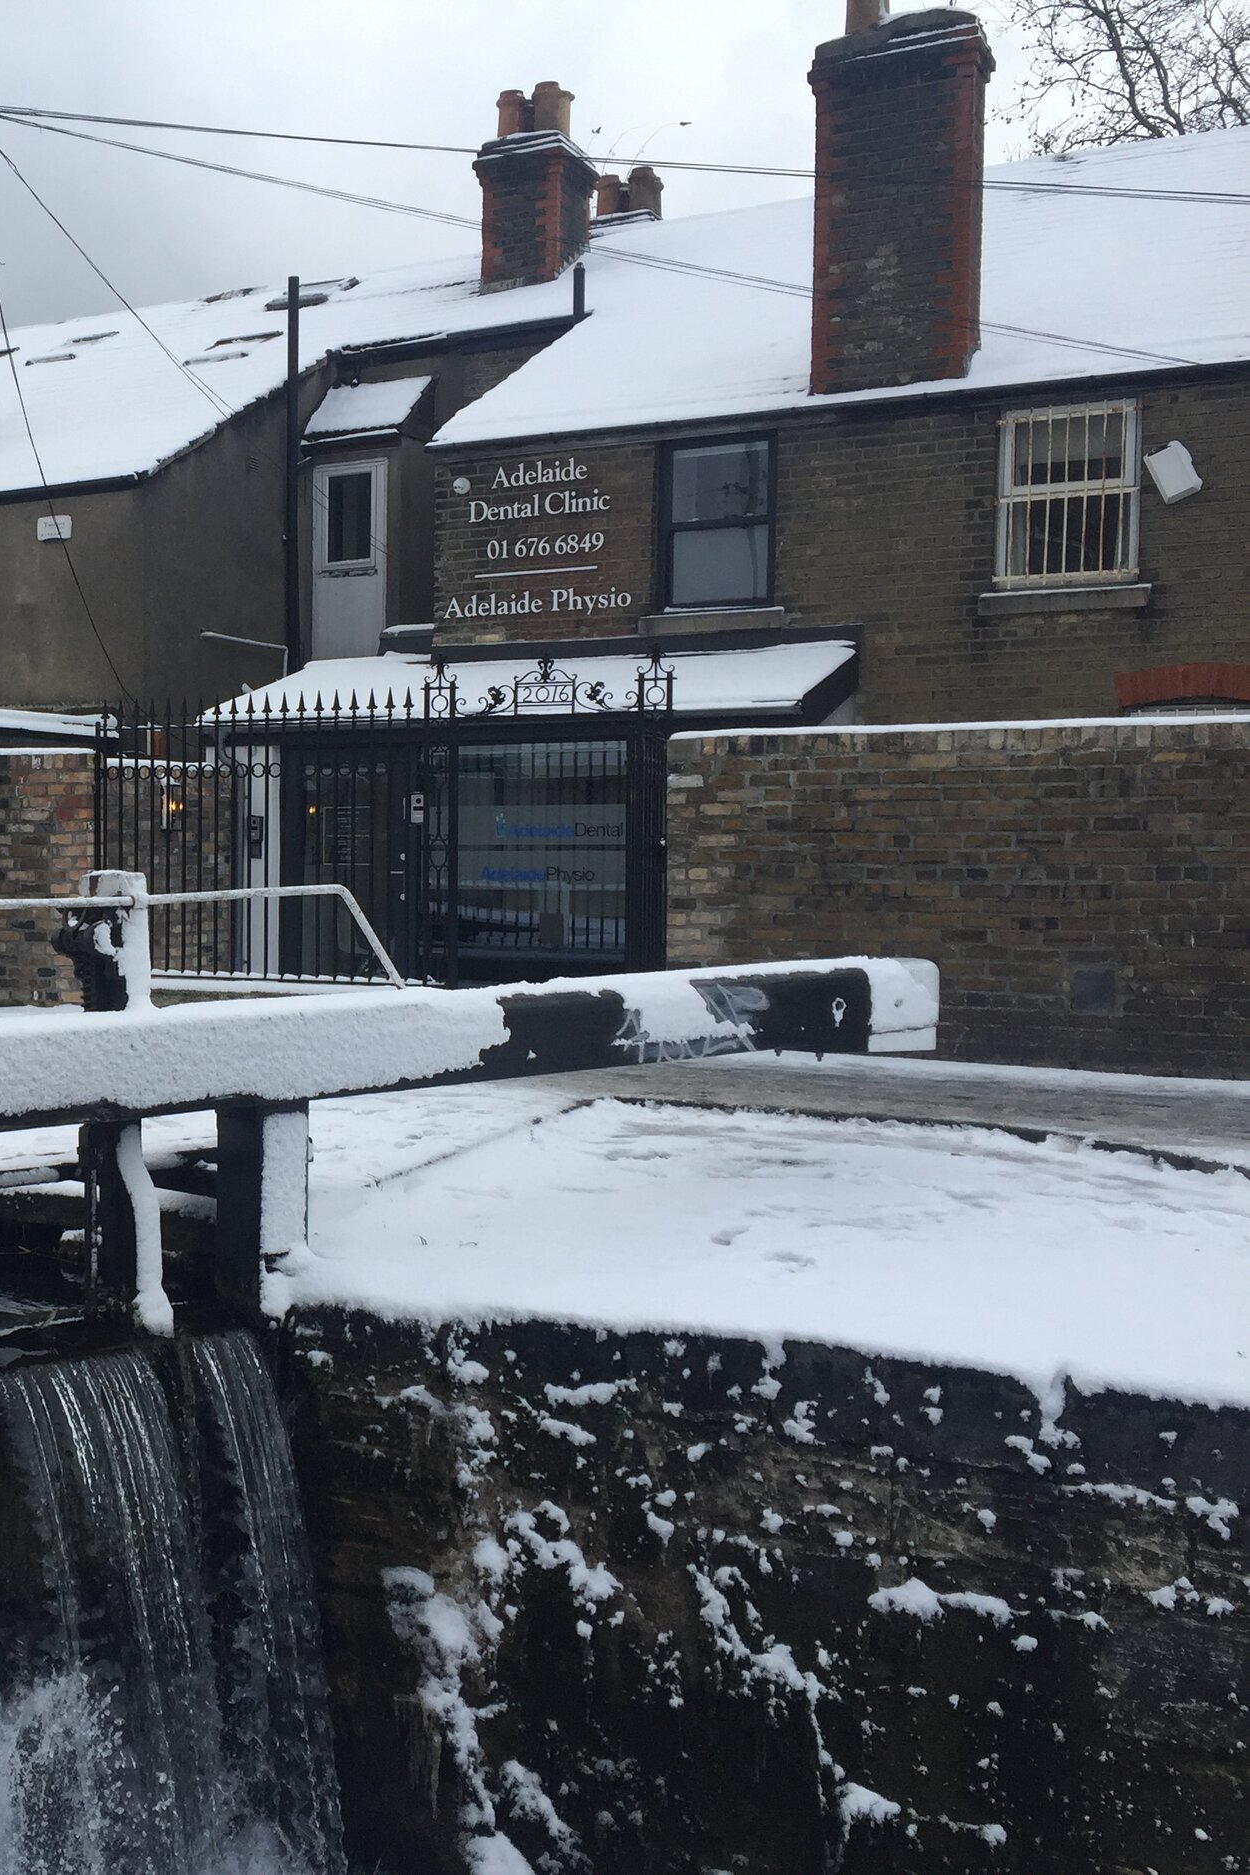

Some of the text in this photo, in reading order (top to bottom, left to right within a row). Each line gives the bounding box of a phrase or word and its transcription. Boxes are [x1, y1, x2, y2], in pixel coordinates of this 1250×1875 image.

[491, 458, 588, 489] Adelaide
[469, 489, 611, 523] Dental Clinic
[487, 532, 604, 560] 01 676 6849
[443, 587, 632, 619] Adelaide Physio
[522, 685, 569, 703] 2016
